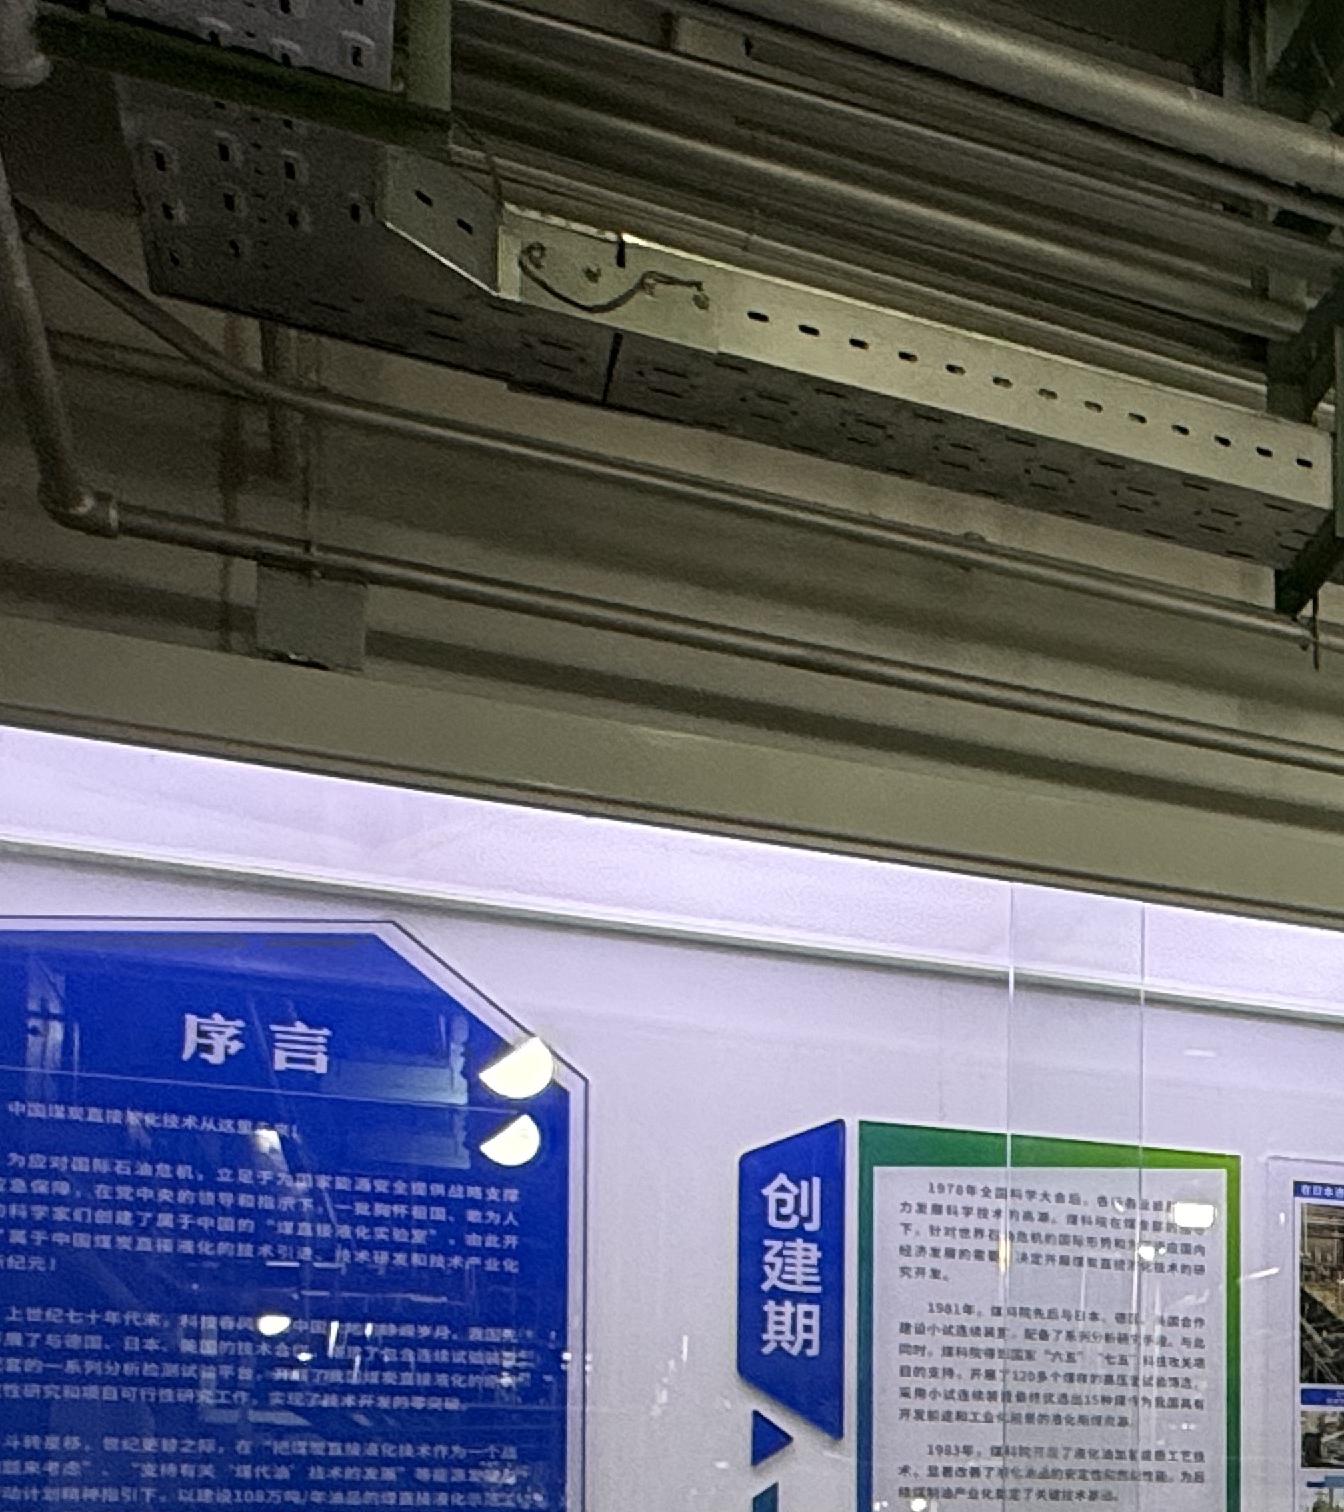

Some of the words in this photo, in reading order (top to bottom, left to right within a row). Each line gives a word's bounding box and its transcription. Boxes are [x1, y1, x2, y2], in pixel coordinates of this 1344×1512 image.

[181, 1012, 333, 1074] 序言
[760, 1173, 822, 1358] 创建期
